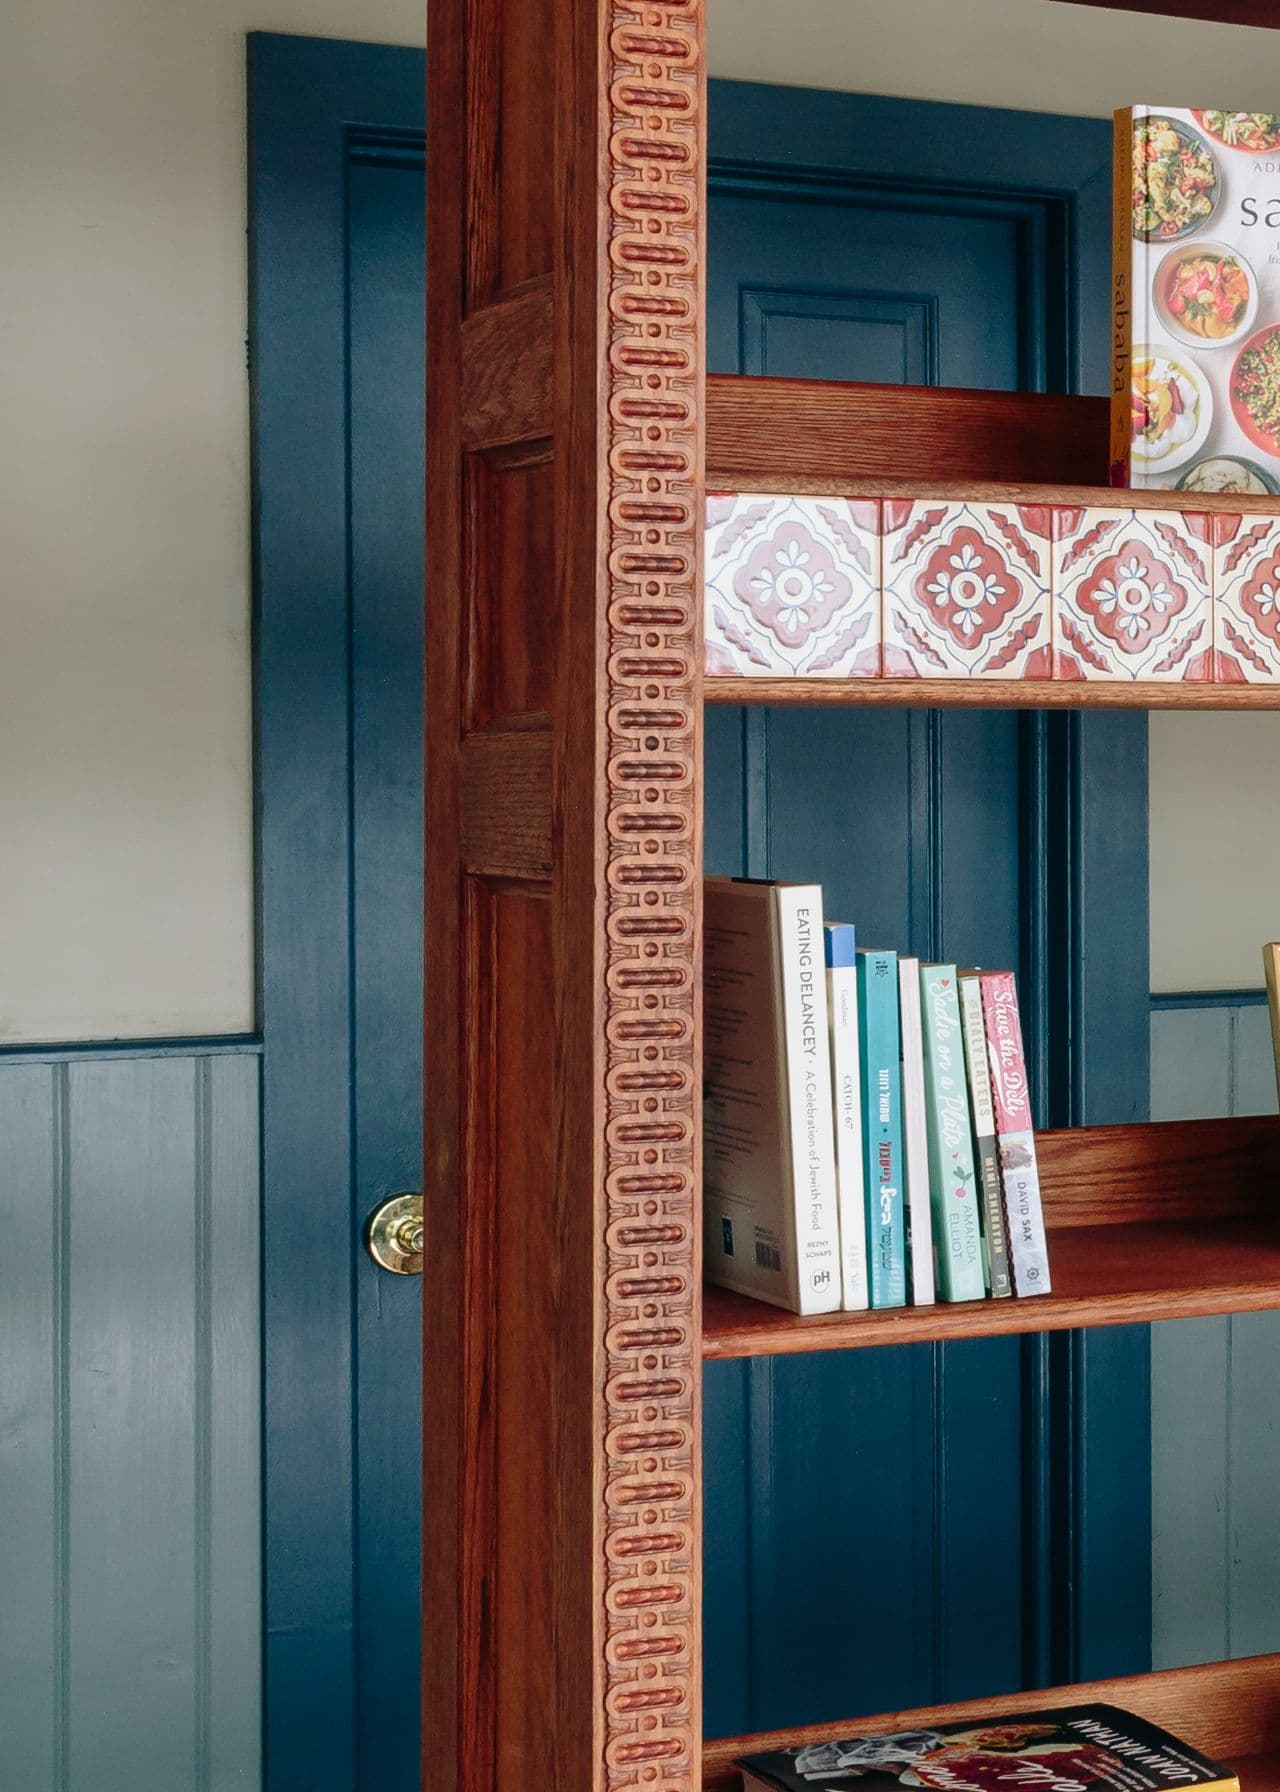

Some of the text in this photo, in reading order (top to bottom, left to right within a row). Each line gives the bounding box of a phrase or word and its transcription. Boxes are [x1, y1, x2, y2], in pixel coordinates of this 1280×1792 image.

[1113, 274, 1129, 393] sababa
[797, 909, 822, 1231] EATING DELANCEY Celebration Jewish Food
[929, 984, 966, 1148] Sadie on a Plate
[974, 1061, 990, 1116] EATERS
[992, 991, 1028, 1117] Save the Deli
[951, 1213, 963, 1259] ELLIOT
[963, 1205, 976, 1264] AMANDA
[984, 1157, 1003, 1253] MIMI SHERATON
[1018, 1181, 1032, 1241] DAVID SAX
[1140, 1752, 1198, 1782] JOAN
